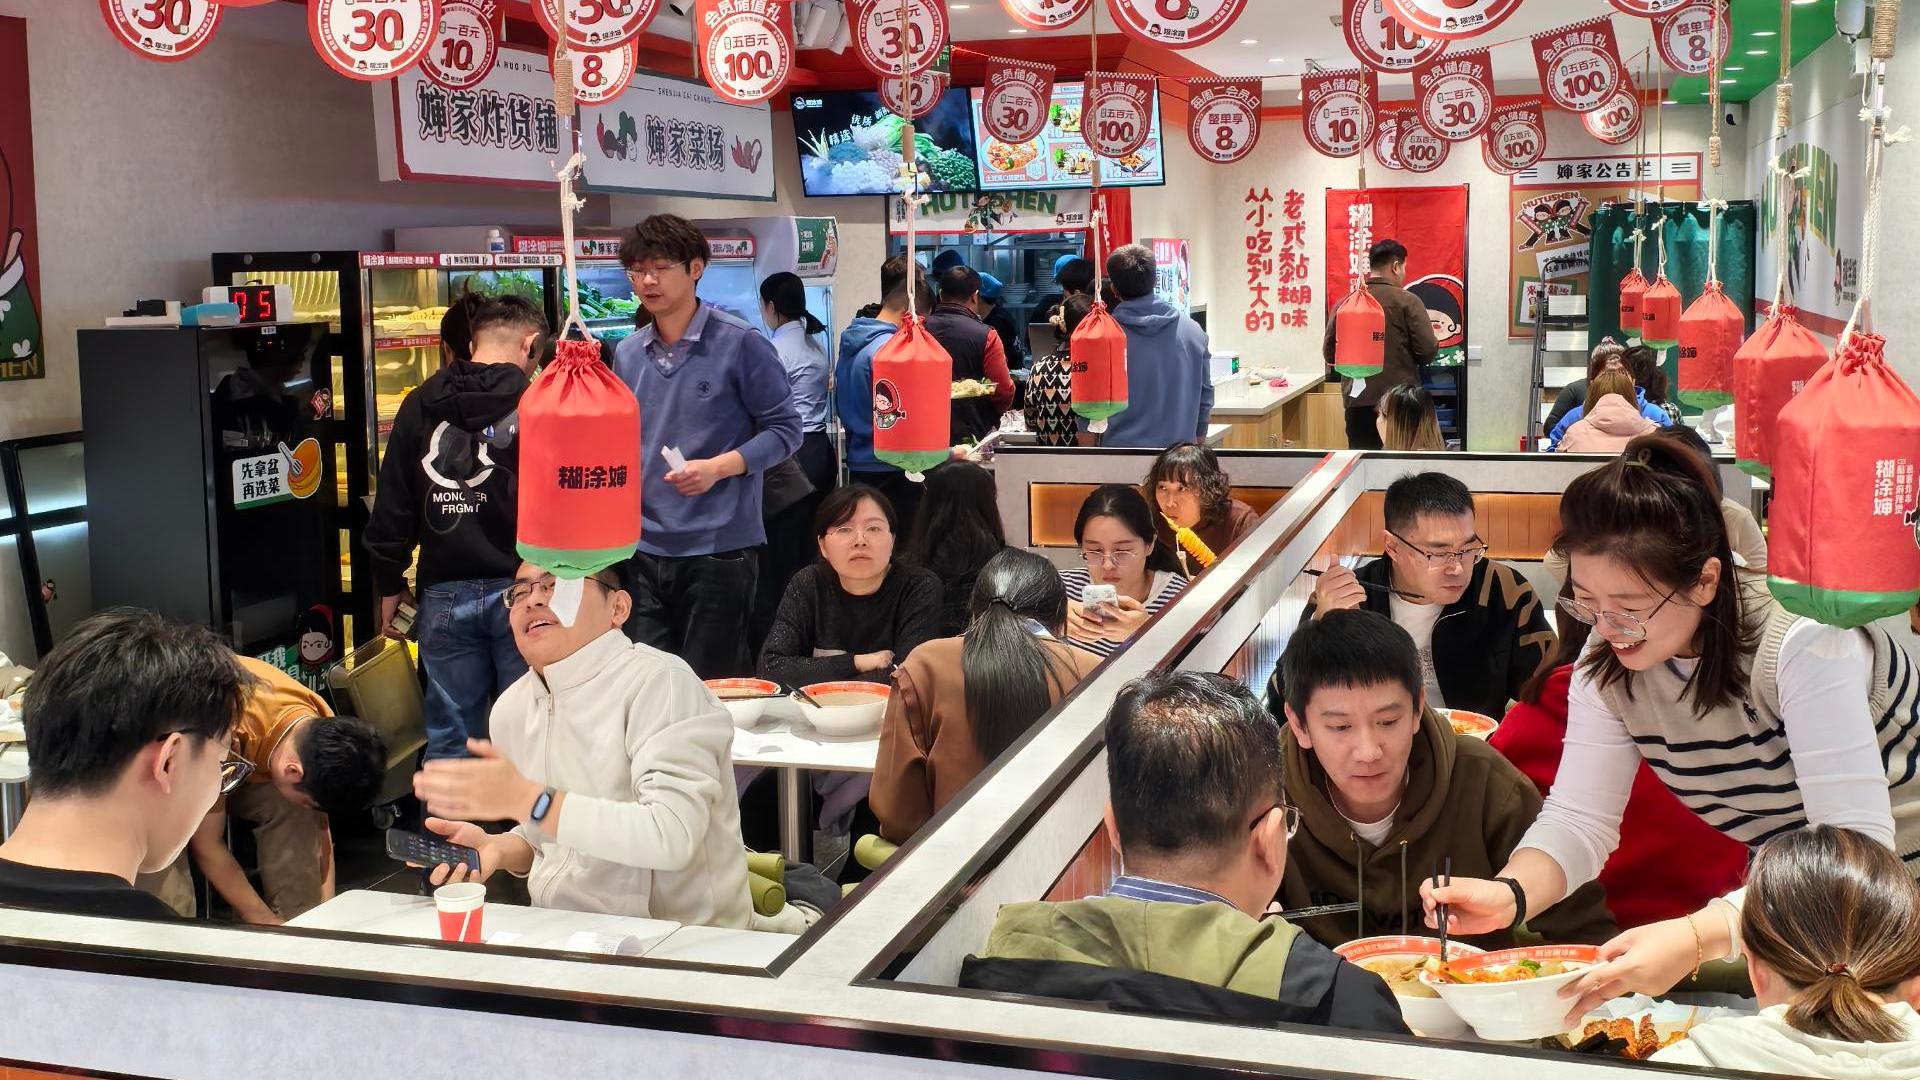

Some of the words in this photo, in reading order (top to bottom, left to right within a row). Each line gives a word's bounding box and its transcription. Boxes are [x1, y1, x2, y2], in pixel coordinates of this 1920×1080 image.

[447, 24, 480, 38] 一百元
[733, 34, 769, 48] 五百元
[1543, 31, 1607, 62] 会员储值礼
[1688, 35, 1706, 61] 8
[1569, 58, 1600, 74] 五百元
[418, 84, 559, 153] 婶家炸货铺
[1209, 114, 1243, 124] 整单享
[646, 115, 725, 172] 婶家菜场
[1557, 161, 1652, 180] 婶家公告栏
[1245, 187, 1274, 331] 从小吃到大的
[1277, 188, 1312, 328] 老式黏糊味
[242, 458, 280, 479] 先拿盆
[559, 465, 628, 490] 糊涂婶
[242, 477, 281, 500] 再选菜
[433, 491, 488, 504] MONCER
[1873, 459, 1894, 516] 糊涂婶
